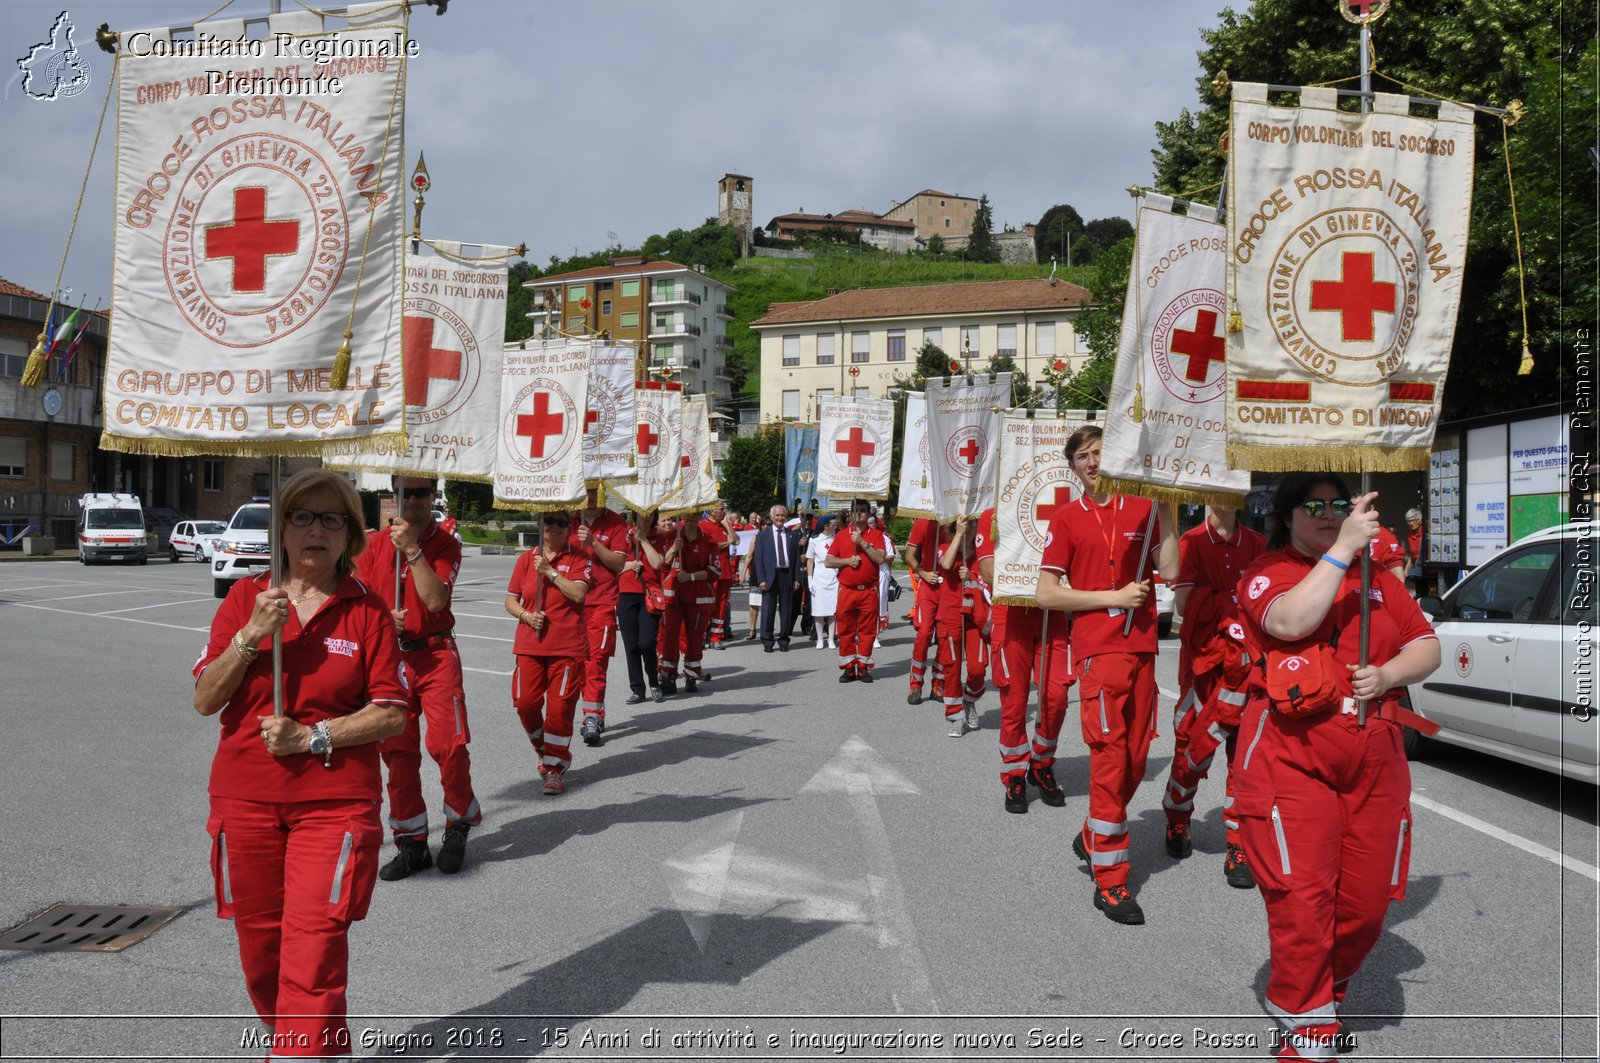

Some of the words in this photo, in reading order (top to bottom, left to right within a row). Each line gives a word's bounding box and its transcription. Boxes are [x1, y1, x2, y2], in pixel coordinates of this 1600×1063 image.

[136, 80, 182, 105] CORPO
[1248, 121, 1290, 144] CORPO
[1294, 125, 1363, 148] VOLONTARI
[1372, 130, 1395, 148] DEL
[126, 134, 193, 229] CROCE
[190, 95, 287, 142] ROSSA
[294, 100, 389, 213] ITALIANA
[221, 139, 313, 178] GINEVRA
[193, 164, 215, 190] DI
[309, 174, 333, 204] 22
[1235, 188, 1293, 264] CROCE
[1294, 167, 1383, 198] ROSSA
[1387, 179, 1452, 283] ITALIANA
[1299, 225, 1321, 249] DI
[1326, 213, 1400, 250] GINEVRA
[170, 196, 227, 336] CONVENZIONE
[306, 207, 341, 292] AGOSTO
[1147, 243, 1188, 288] CROCE
[1190, 237, 1227, 253] ROSS
[404, 281, 439, 295] OSSA
[444, 284, 505, 300] ITALIANA
[431, 268, 450, 282] DEL
[452, 270, 500, 285] SOCCORSO
[265, 291, 315, 334] 1864
[1273, 250, 1337, 375] CONVENZIONE
[442, 310, 476, 353] GINEVRA
[1154, 303, 1181, 382] CONVENZIONE
[1180, 298, 1190, 309] DI
[1191, 292, 1225, 309] GINEVR
[116, 368, 236, 396] GRUPPO
[245, 369, 272, 394] DI
[286, 363, 392, 393] MELE
[115, 399, 249, 432] COMITATO
[267, 400, 386, 430] LOCALE
[1237, 406, 1344, 426] COMITATO
[1352, 408, 1374, 426] DI
[423, 433, 474, 447] LOCALE
[1175, 435, 1190, 450] DI
[1513, 450, 1524, 458] PER
[1525, 447, 1546, 458] QUESTO
[1001, 462, 1033, 503] CROCE
[1020, 489, 1045, 550] ONVENZIONE
